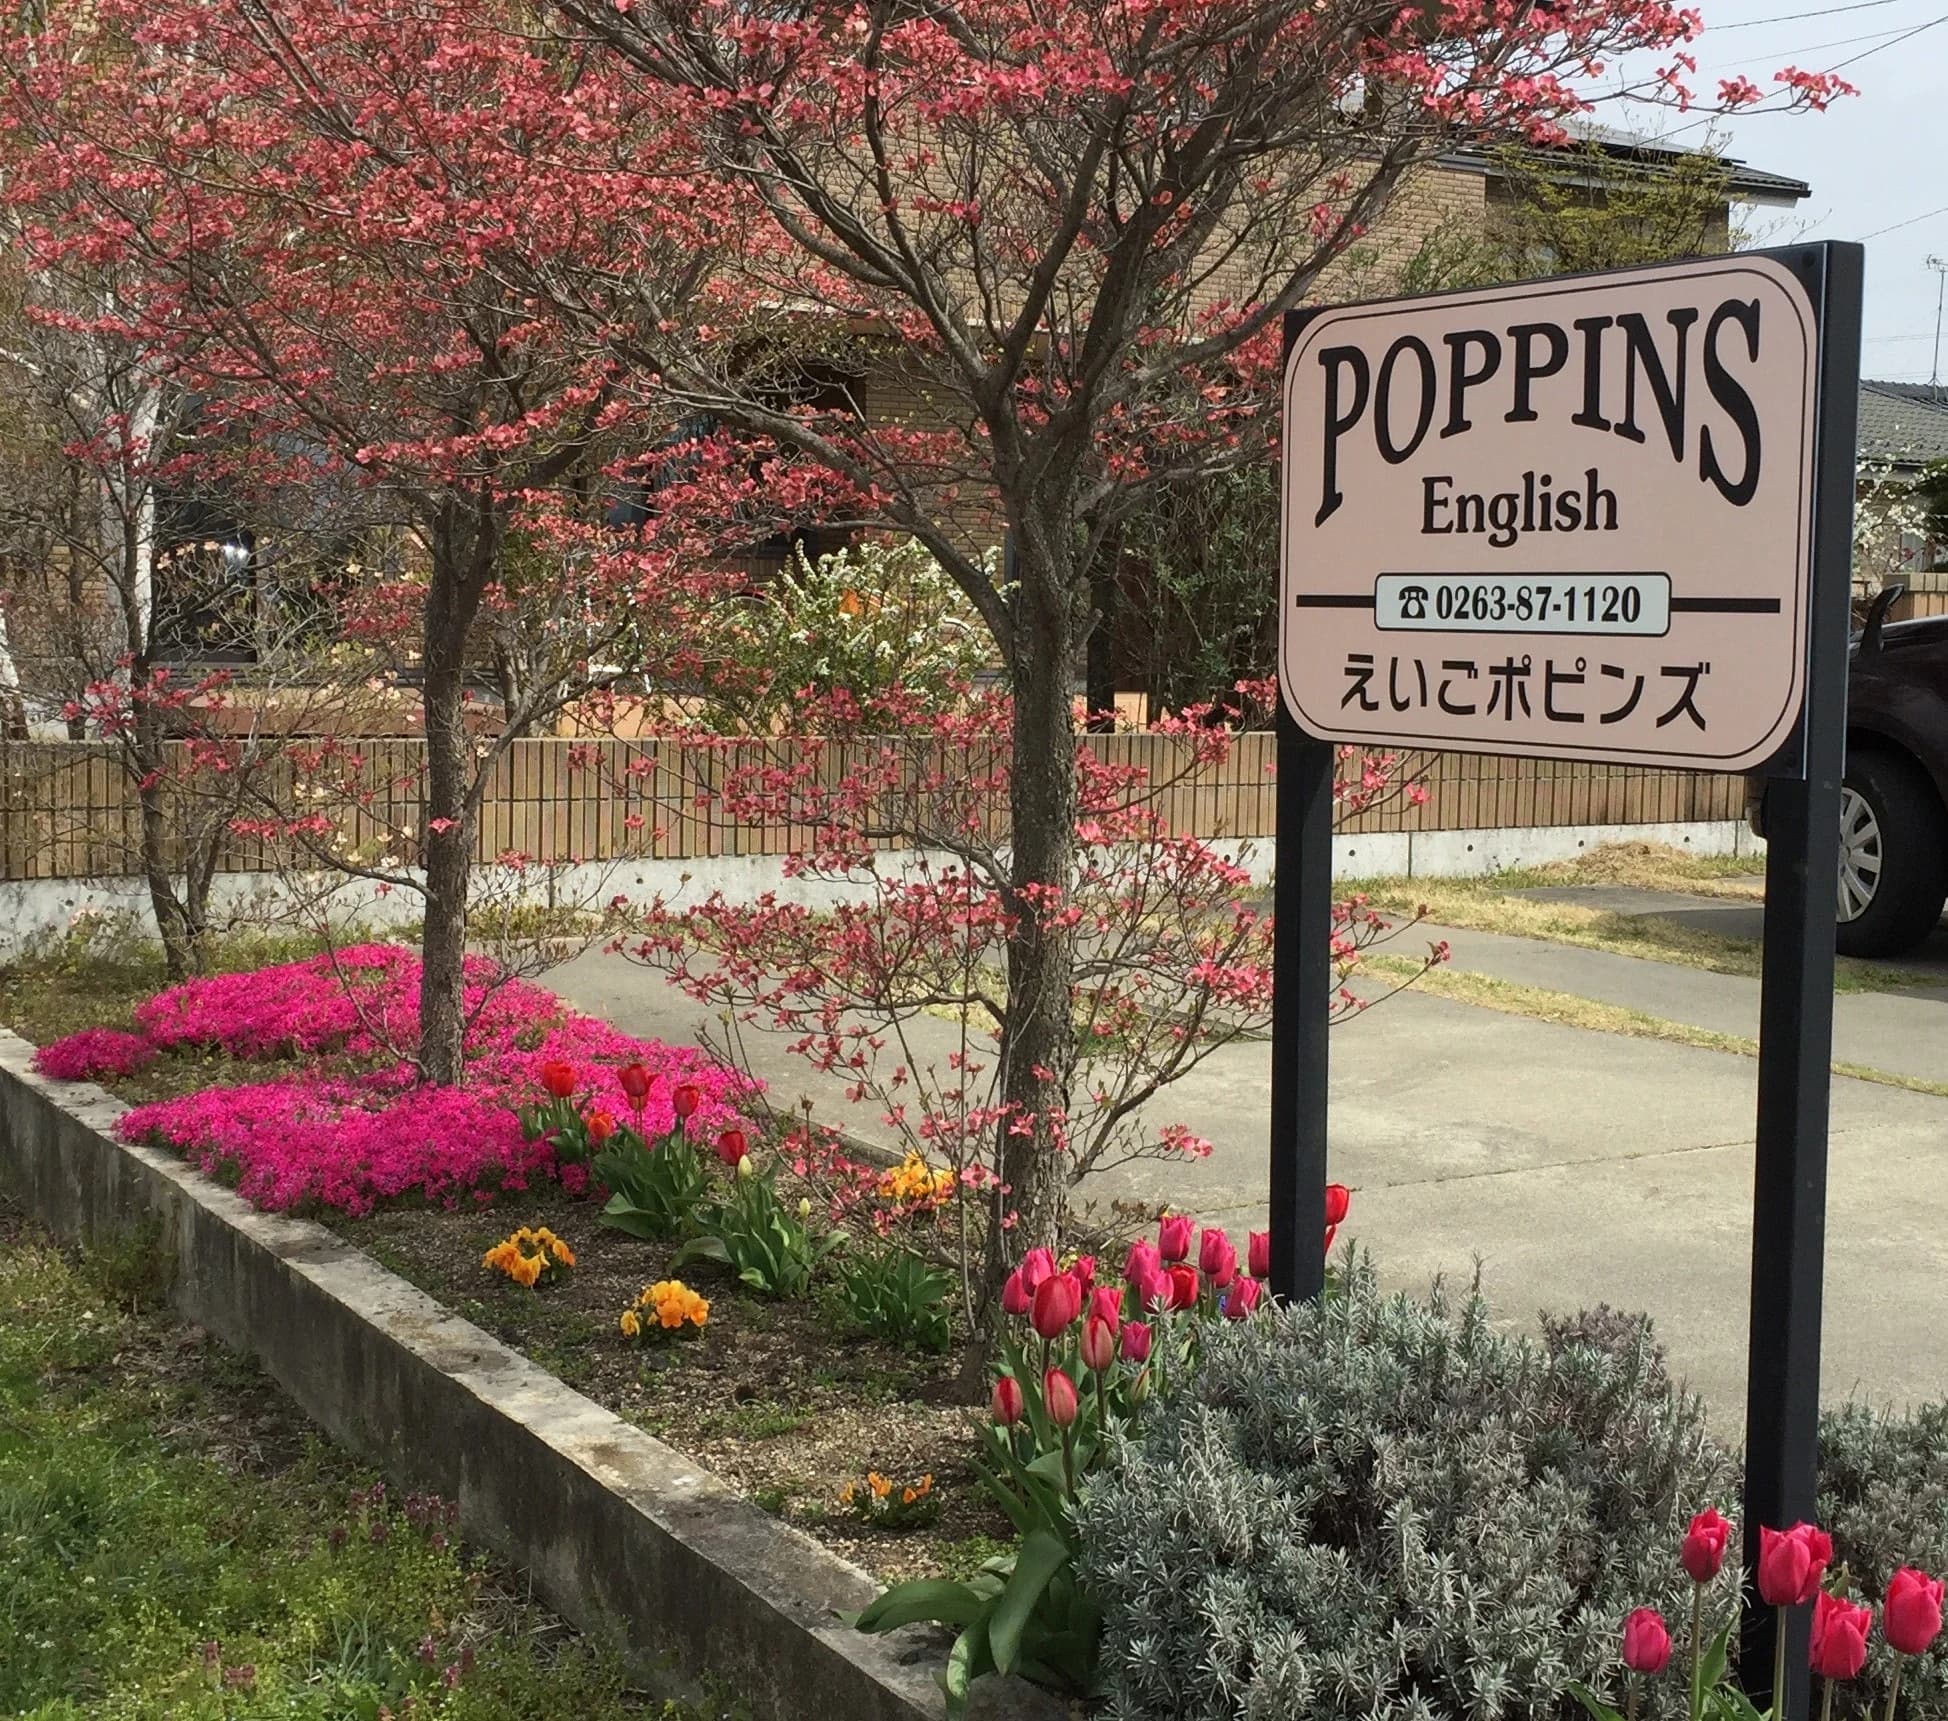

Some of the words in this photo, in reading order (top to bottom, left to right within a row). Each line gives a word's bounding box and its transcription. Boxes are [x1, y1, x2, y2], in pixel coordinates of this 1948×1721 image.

[1315, 298, 1762, 528] POPPINS
[1421, 467, 1618, 547] English
[1436, 585, 1641, 624] 0263-87-1120
[1340, 653, 1711, 731] えいごポピンズ
